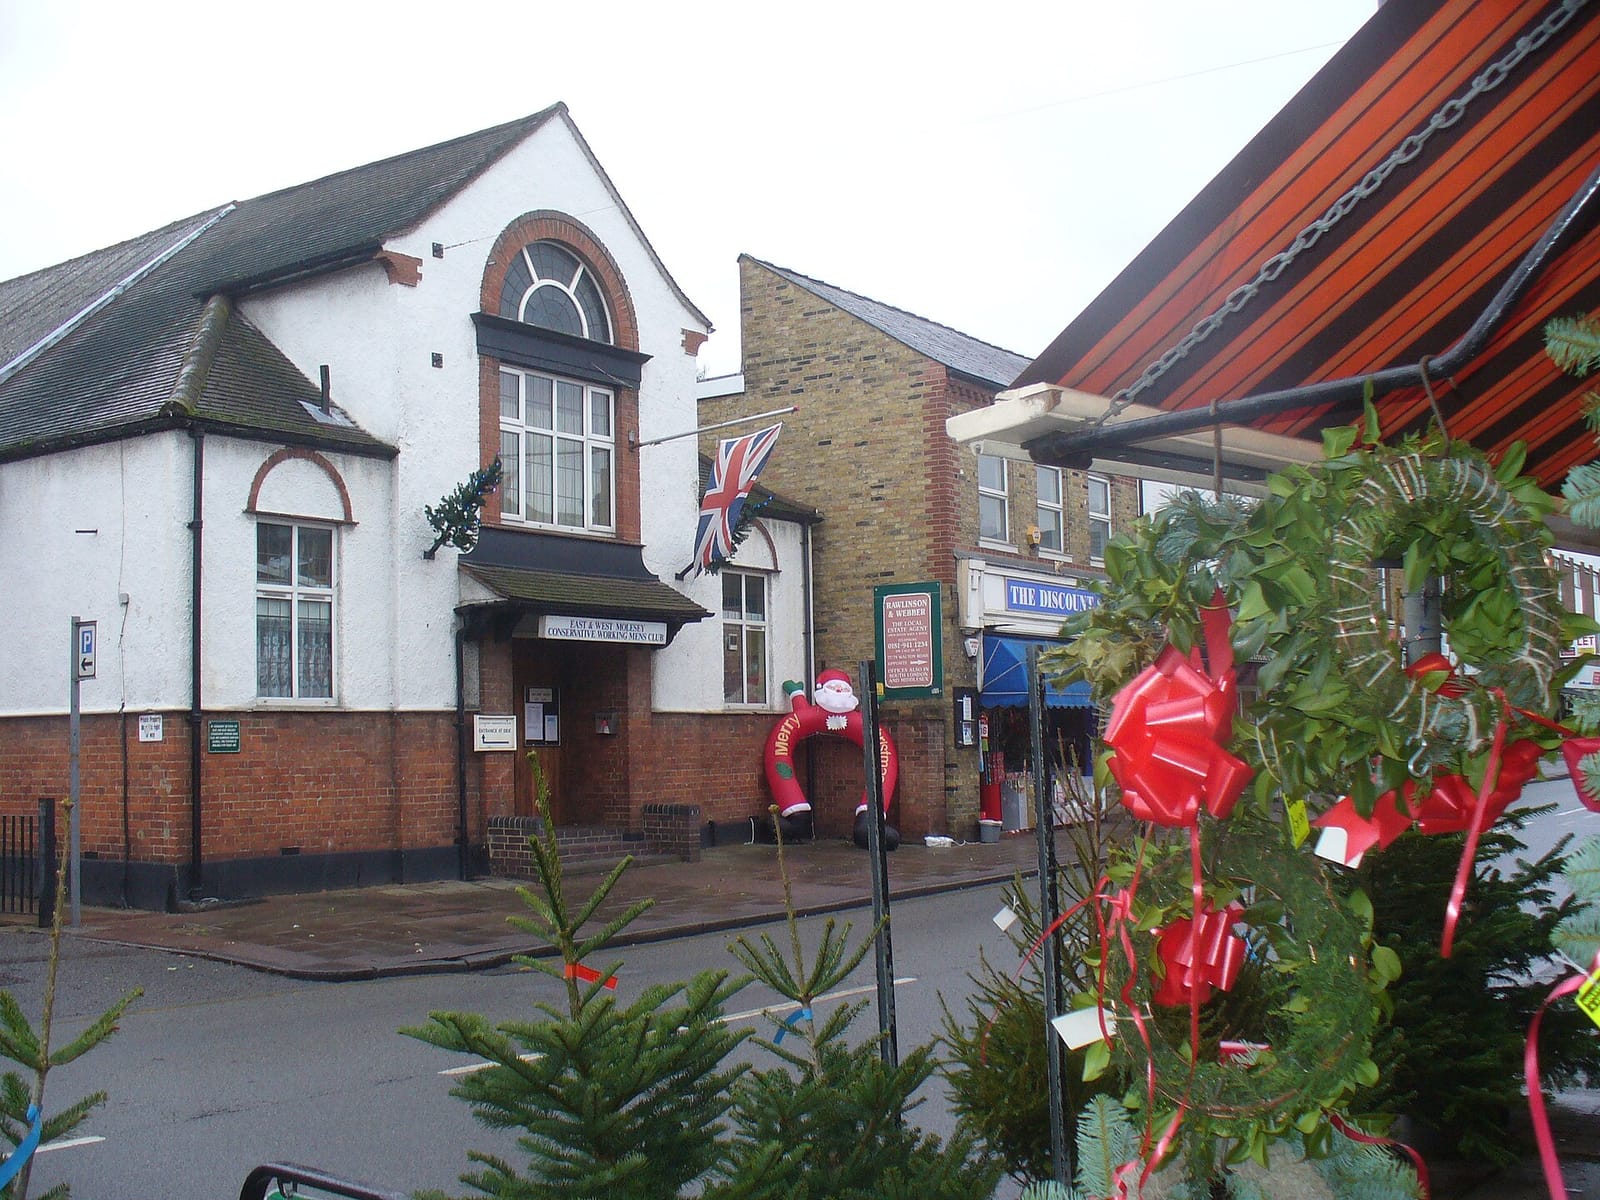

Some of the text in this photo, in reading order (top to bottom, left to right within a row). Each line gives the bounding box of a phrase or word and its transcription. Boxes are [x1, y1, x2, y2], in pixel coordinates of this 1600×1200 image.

[886, 599, 928, 609] RAWLINSON
[1010, 585, 1036, 606] THE
[1039, 589, 1094, 611] DISCOUNT
[888, 608, 926, 618] & WEBBER
[570, 619, 646, 633] EAST & WEST MOLESEY
[909, 625, 928, 633] AGENT
[547, 627, 664, 642] CONSERVATIVE WORKING MENS CLUB
[1577, 635, 1594, 646] LET
[83, 632, 91, 653] P
[775, 713, 801, 756] Merry
